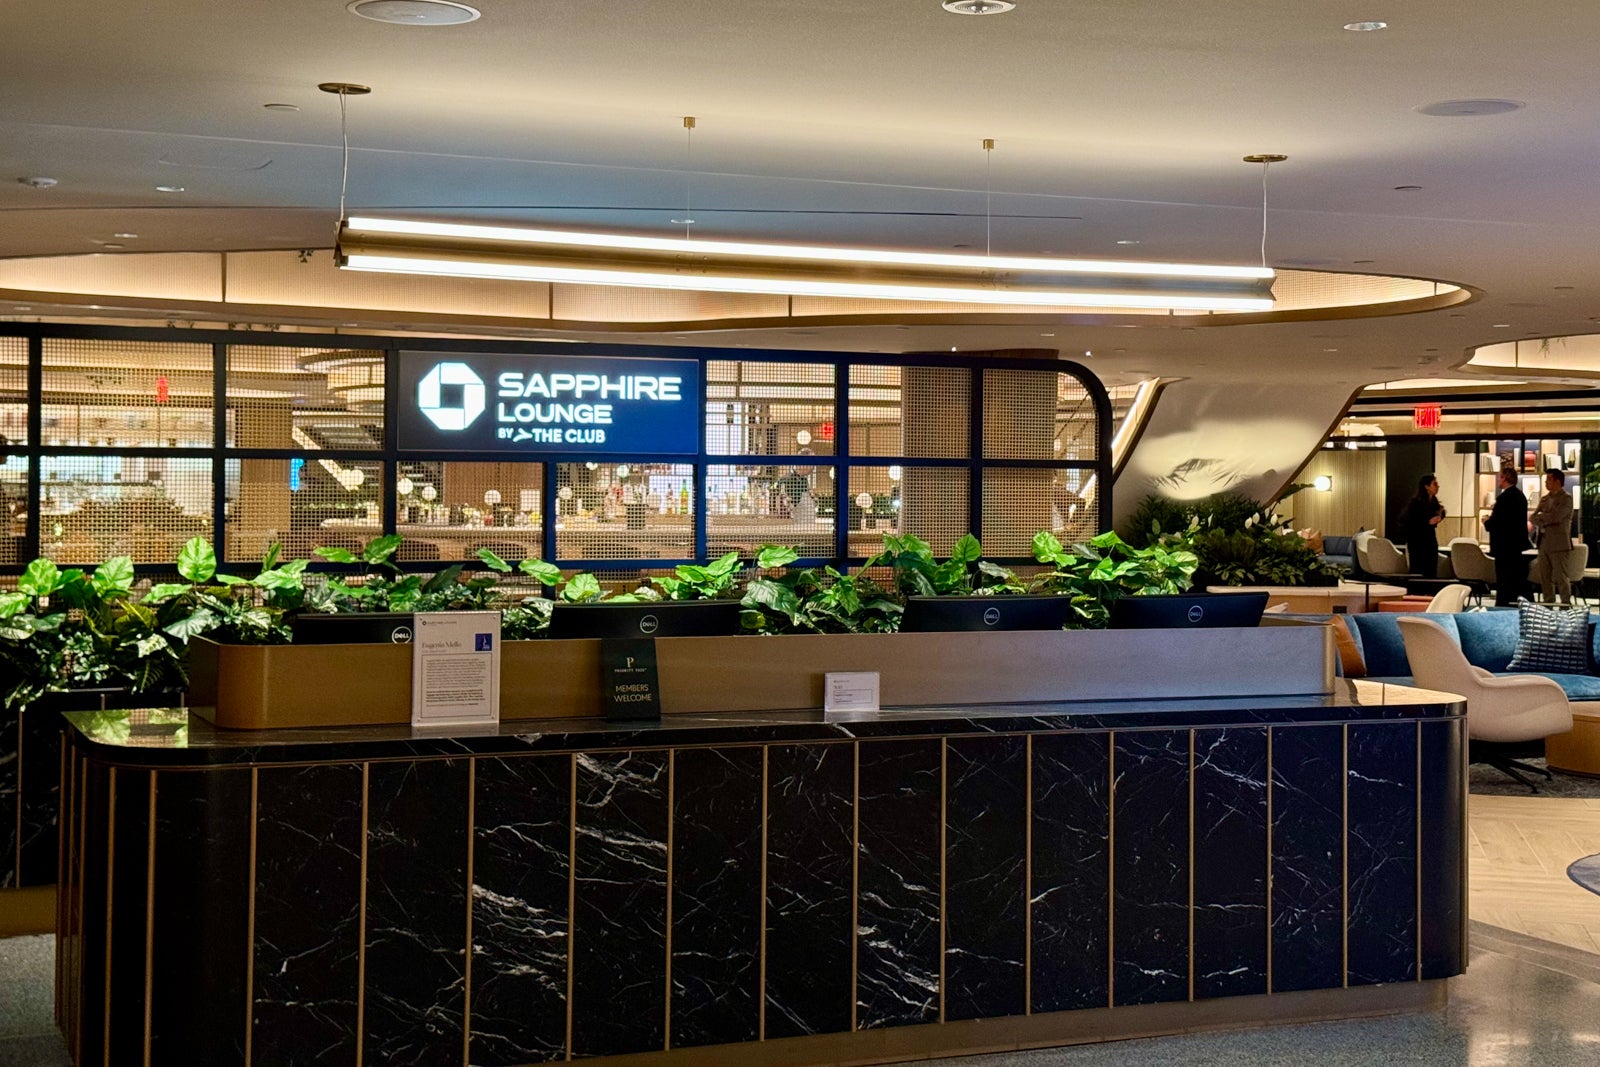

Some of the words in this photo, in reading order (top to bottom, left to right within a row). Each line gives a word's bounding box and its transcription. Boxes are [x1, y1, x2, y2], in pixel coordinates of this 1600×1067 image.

[498, 372, 682, 400] SAPPHIRE
[498, 403, 613, 424] LOUNGE
[498, 428, 514, 439] BY
[533, 429, 563, 443] THE
[565, 430, 606, 444] CLUB
[626, 656, 635, 668] P
[615, 684, 649, 692] MEMBERS
[614, 693, 652, 702] WELCOME
